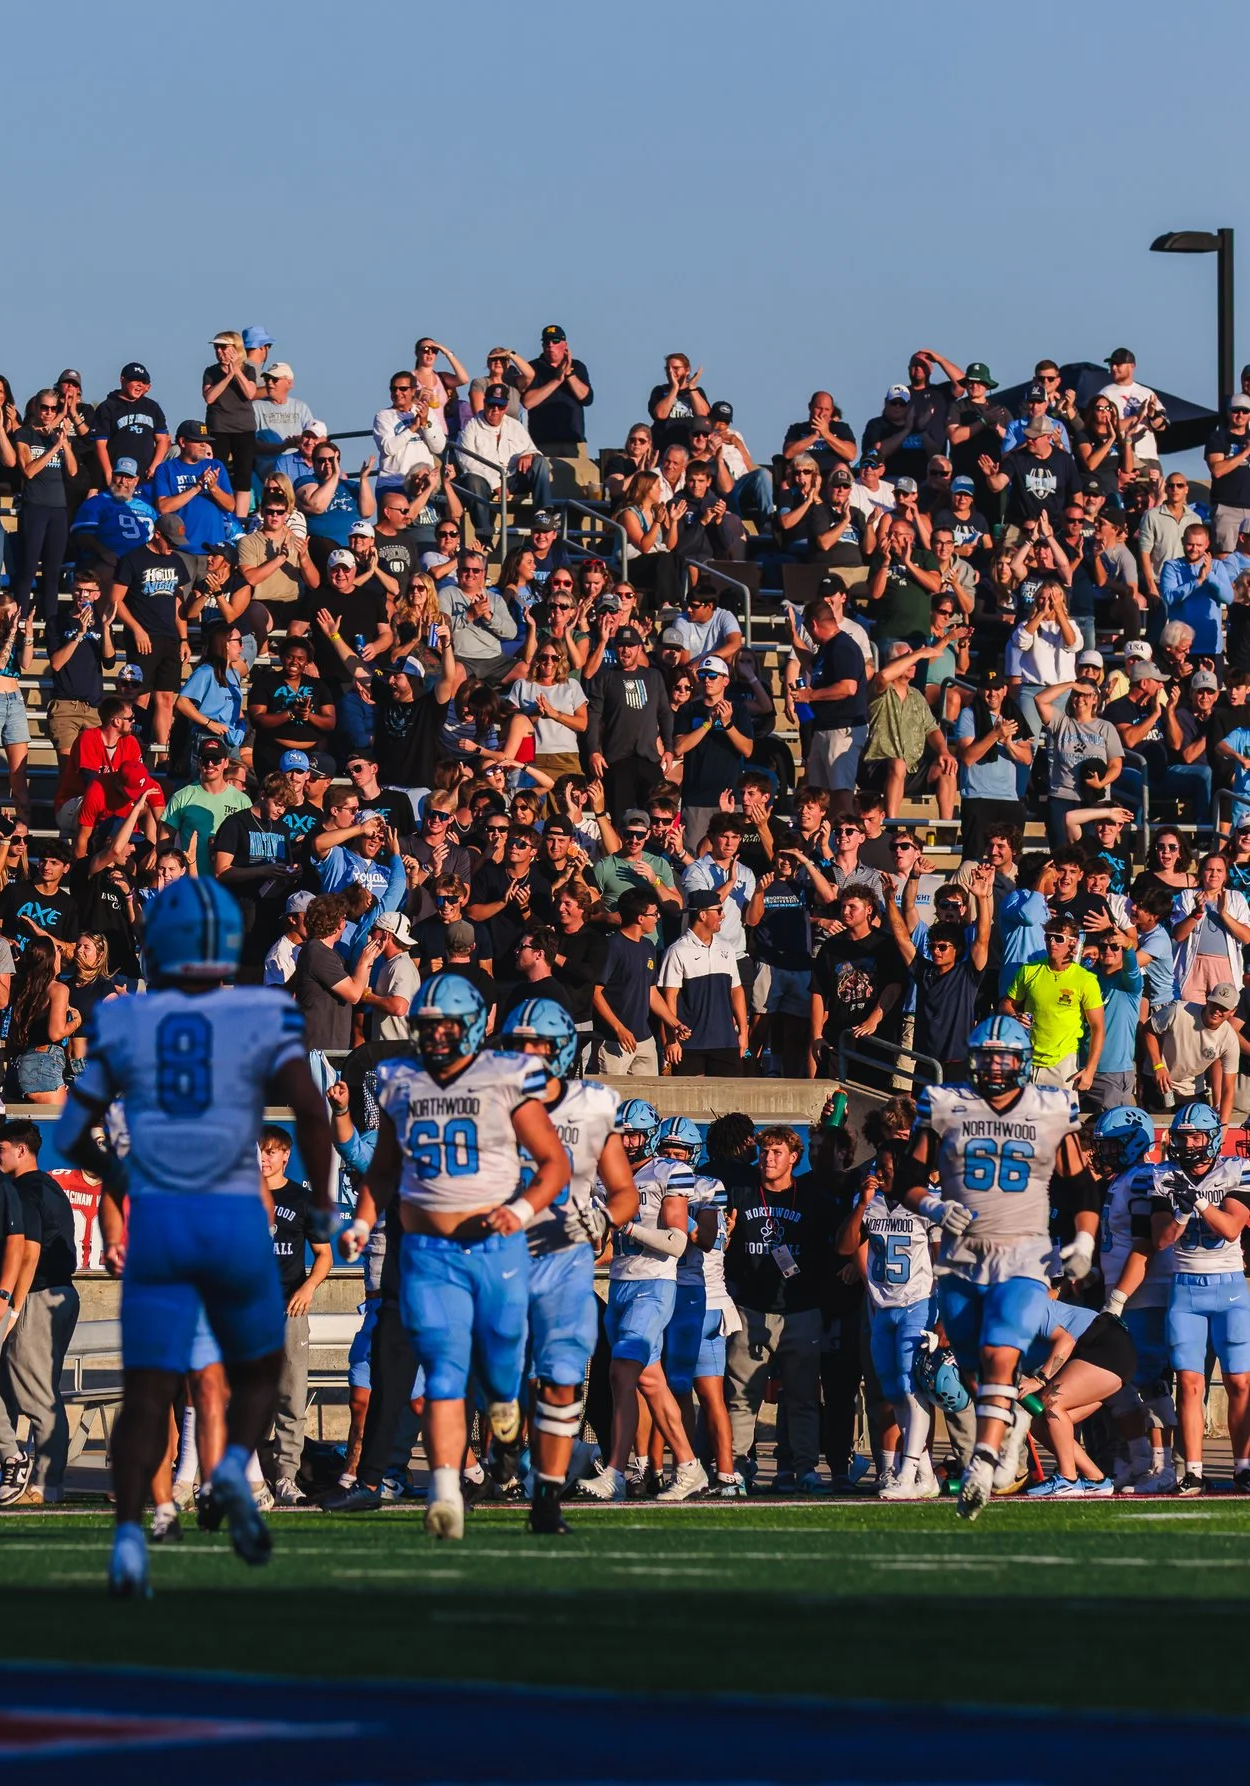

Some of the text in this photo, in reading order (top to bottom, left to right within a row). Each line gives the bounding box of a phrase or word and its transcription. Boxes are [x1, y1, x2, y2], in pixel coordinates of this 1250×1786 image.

[142, 568, 178, 583] HOWL
[143, 580, 178, 593] NIGHT
[1129, 644, 1144, 652] USA
[988, 671, 996, 680] P
[282, 813, 316, 833] AXE
[16, 902, 62, 926] AXE
[155, 1011, 213, 1119] 8
[406, 1096, 480, 1117] NORTHWOOD
[961, 1121, 1037, 1142] NORTHWOOD
[407, 1118, 479, 1180] 60
[963, 1137, 1035, 1193] 66
[744, 1206, 802, 1223] NORTHWOOD
[865, 1218, 914, 1234] NORTHWOOD
[868, 1234, 912, 1285] 85
